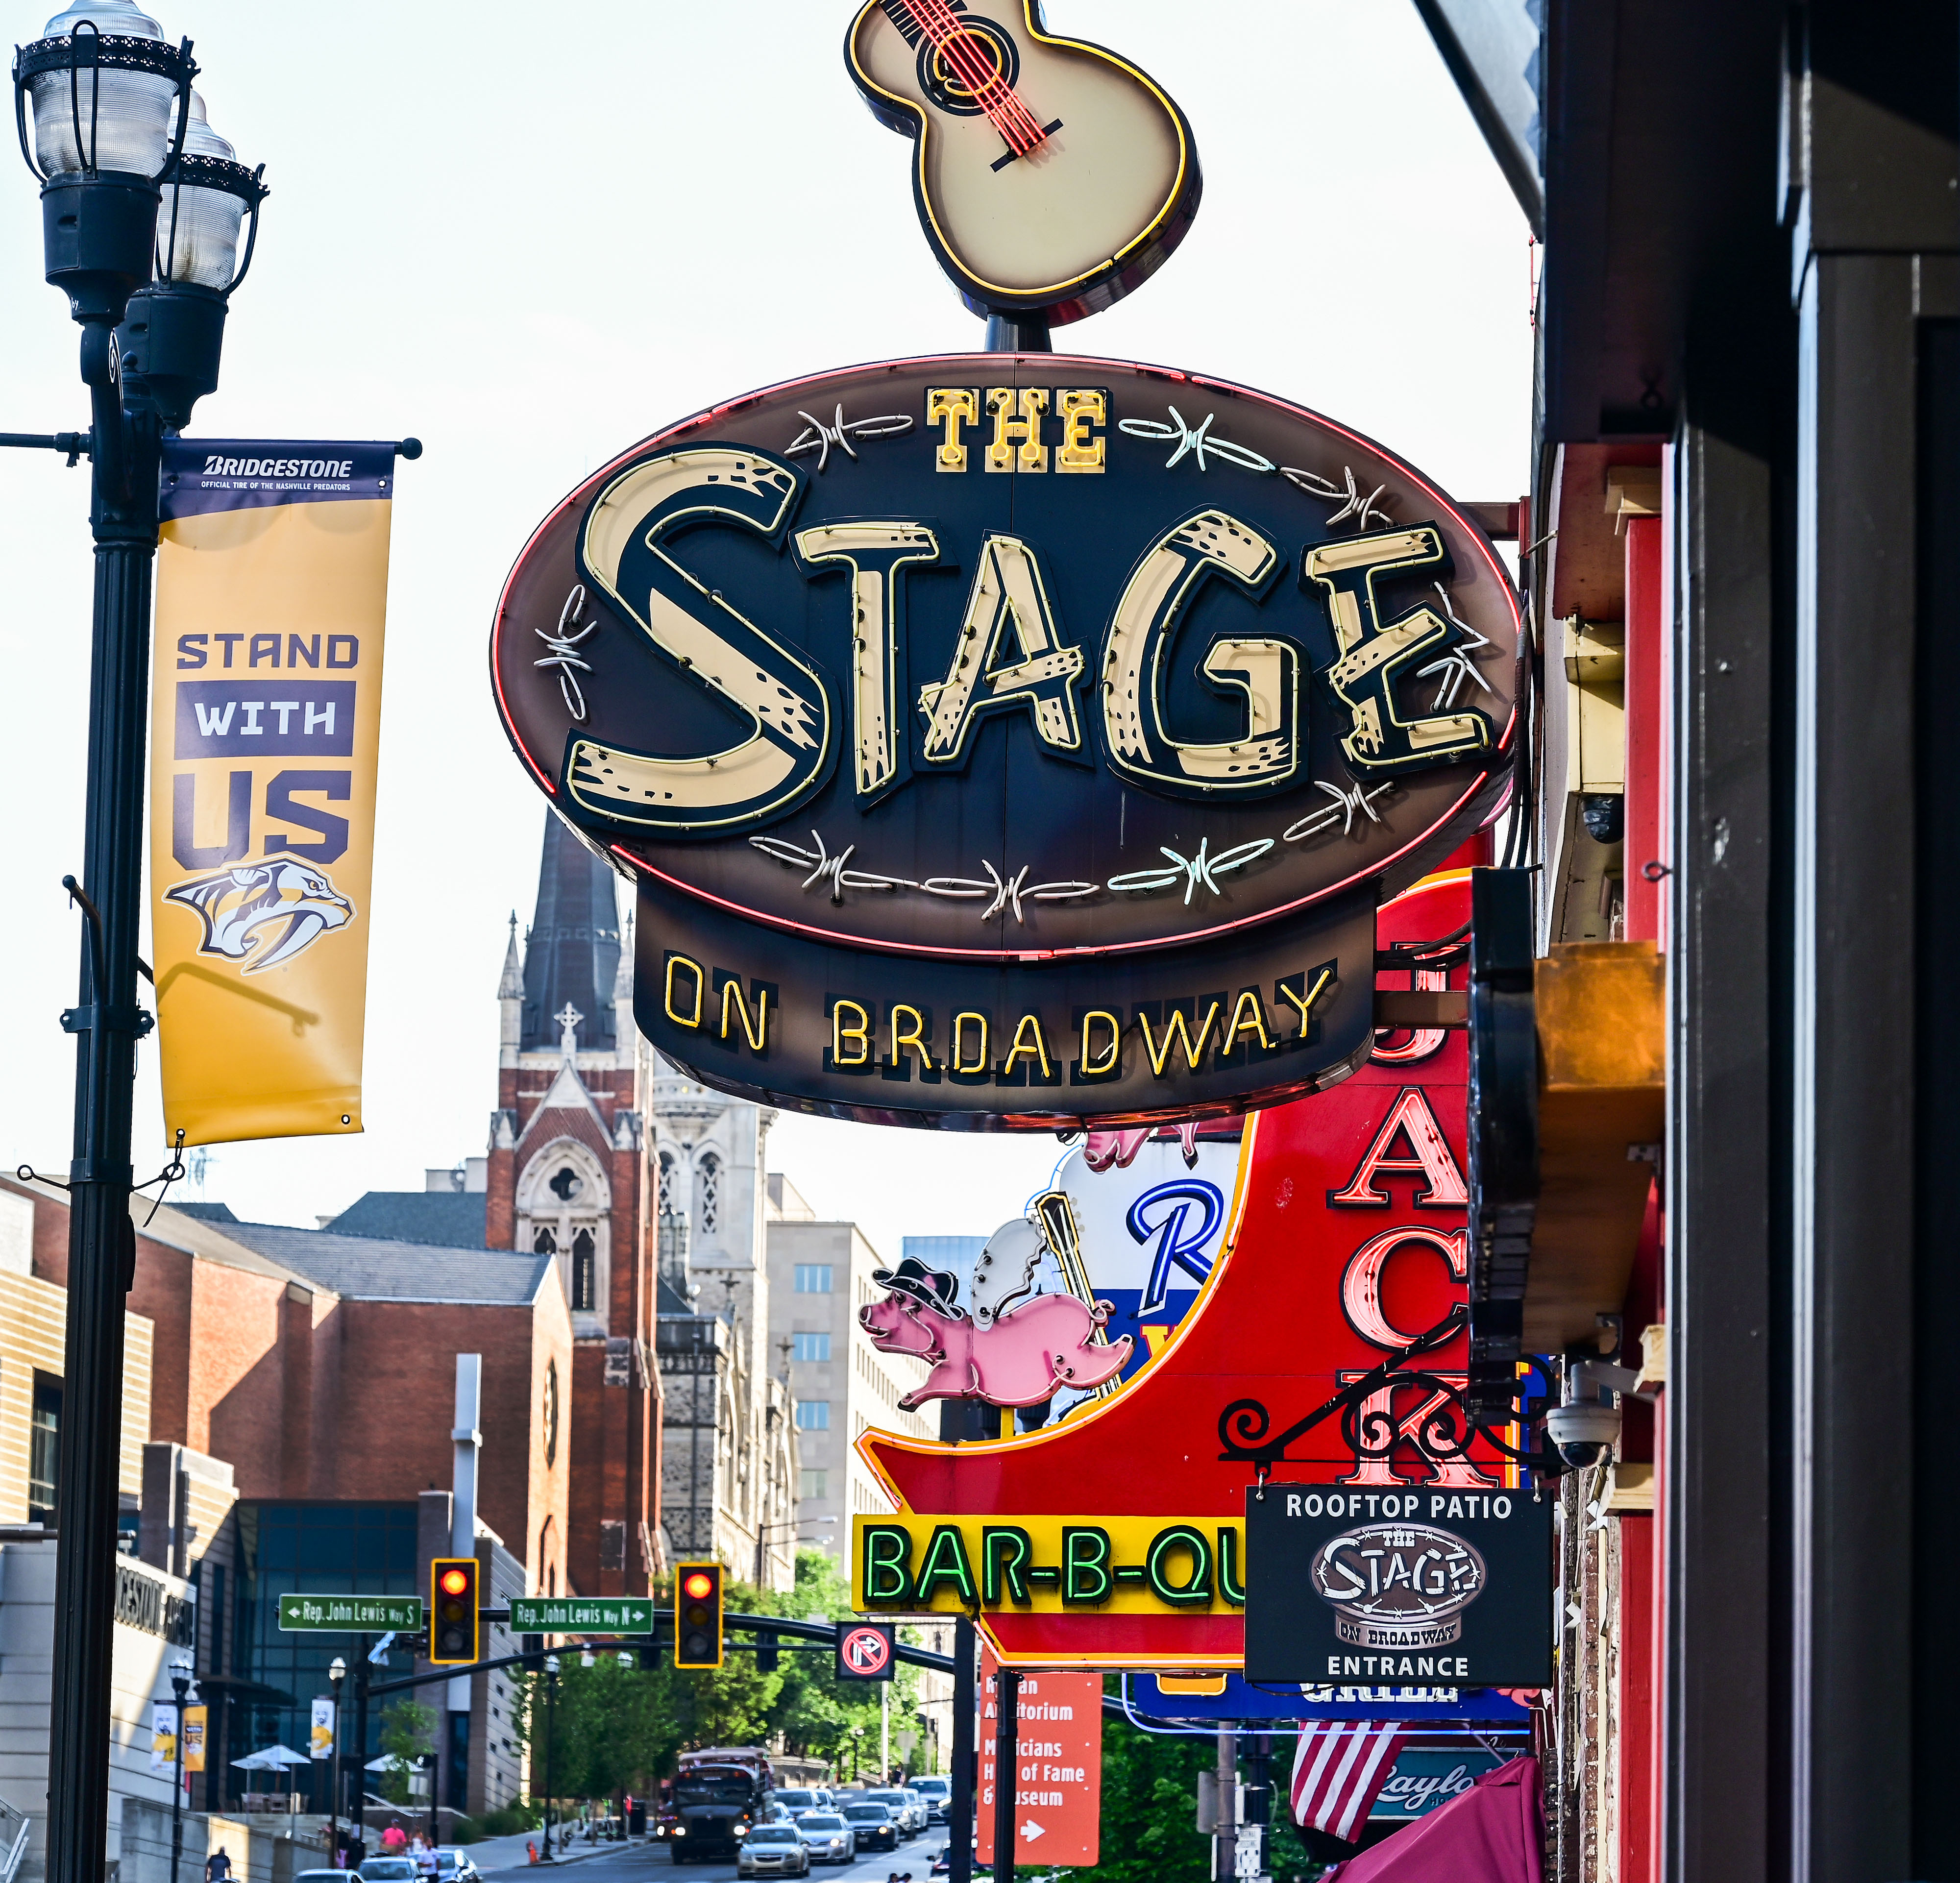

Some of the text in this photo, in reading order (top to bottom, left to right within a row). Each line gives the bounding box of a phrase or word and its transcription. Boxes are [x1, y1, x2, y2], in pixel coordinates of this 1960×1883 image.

[926, 388, 1106, 474] THE
[202, 455, 353, 478] BRIDGESTONE
[201, 481, 230, 489] OFFICIAL
[564, 445, 1491, 830] STAGE
[177, 634, 359, 669] STAND
[194, 702, 336, 736] WITH
[172, 770, 352, 871] US
[664, 952, 1336, 1081] ON BROADWAY
[1287, 1494, 1512, 1519] ROOFTOP PATIO
[1382, 1531, 1415, 1547] THE
[1323, 1538, 1476, 1599] STAGE
[303, 1601, 325, 1624] Rep.
[326, 1602, 352, 1621] John
[354, 1602, 386, 1622] Lewis
[407, 1605, 415, 1625] S
[517, 1603, 539, 1627] Rep.
[540, 1604, 567, 1623] John
[568, 1603, 601, 1623] Lewis
[621, 1606, 631, 1626] N
[1339, 1621, 1457, 1646] ON BROADWAY
[1328, 1656, 1469, 1676] ENTRANCE
[986, 1676, 1038, 1694] Ran
[984, 1702, 1073, 1720] Aitorium
[984, 1738, 1062, 1757] Micians
[1021, 1762, 1085, 1782] of Fame
[983, 1785, 1063, 1807] & seum
